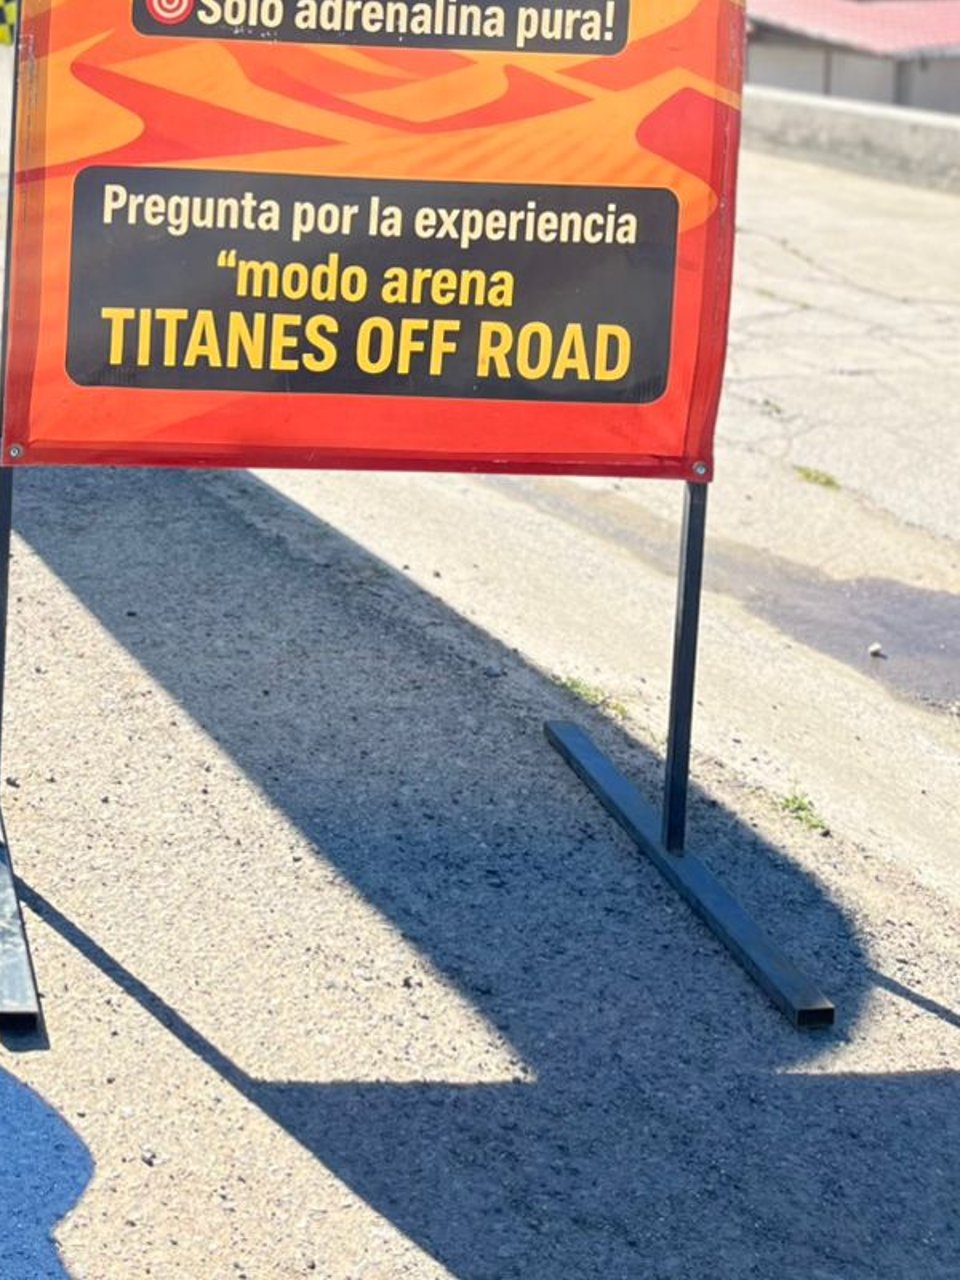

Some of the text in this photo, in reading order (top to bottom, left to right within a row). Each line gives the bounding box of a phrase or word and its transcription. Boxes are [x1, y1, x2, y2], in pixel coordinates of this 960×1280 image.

[516, 0, 615, 48] pura!
[103, 184, 637, 249] Pregunta por la experiencia
[217, 249, 514, 307] “modo arena
[100, 306, 631, 381] TITANES OFF ROAD
